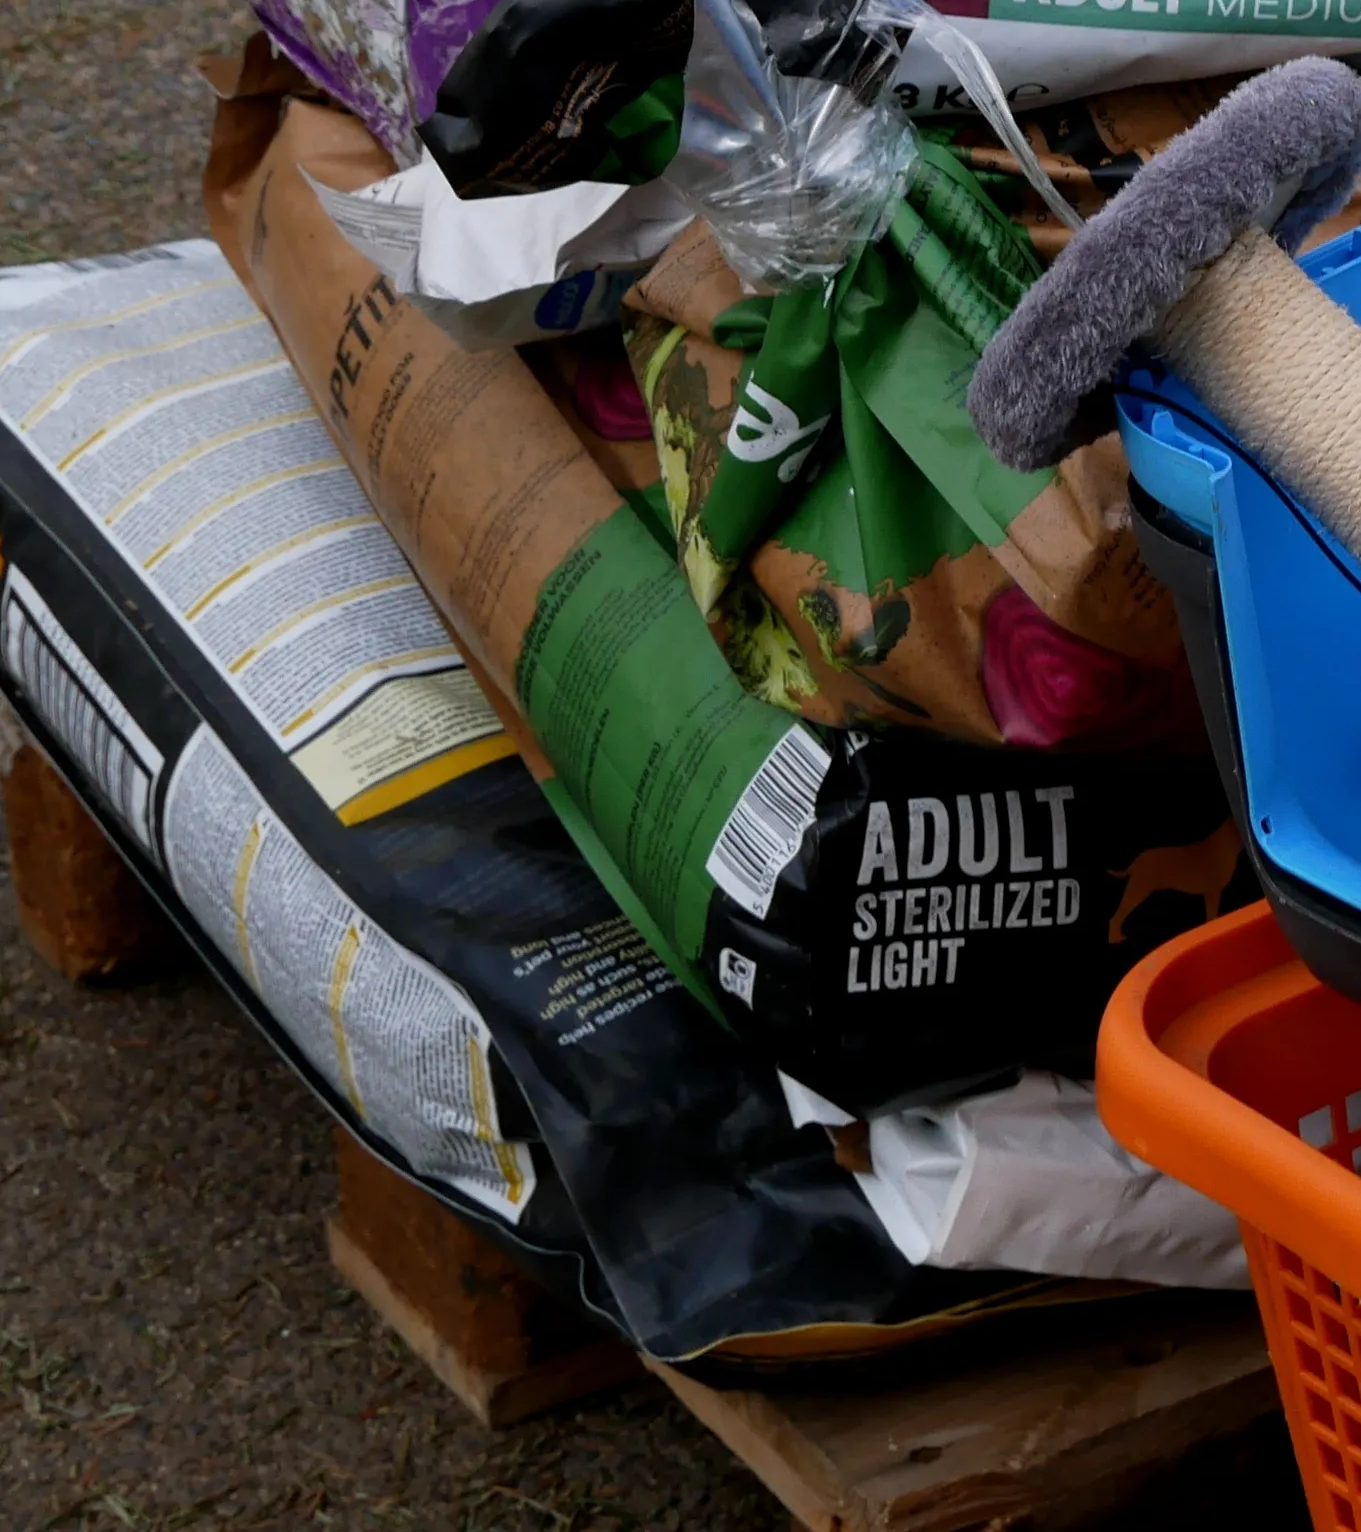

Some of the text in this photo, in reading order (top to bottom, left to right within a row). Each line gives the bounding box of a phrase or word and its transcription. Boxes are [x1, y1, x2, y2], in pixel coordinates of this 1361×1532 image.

[901, 83, 922, 110] 3
[547, 547, 586, 596] VOOR
[856, 784, 1075, 887] ADULT
[852, 878, 1081, 942] STERILIZED
[547, 954, 617, 997] and high
[597, 963, 637, 988] such
[847, 937, 966, 994] LIGHT
[540, 992, 577, 1021] high
[557, 989, 653, 1047] recipes help
[576, 977, 645, 1020] targeted
